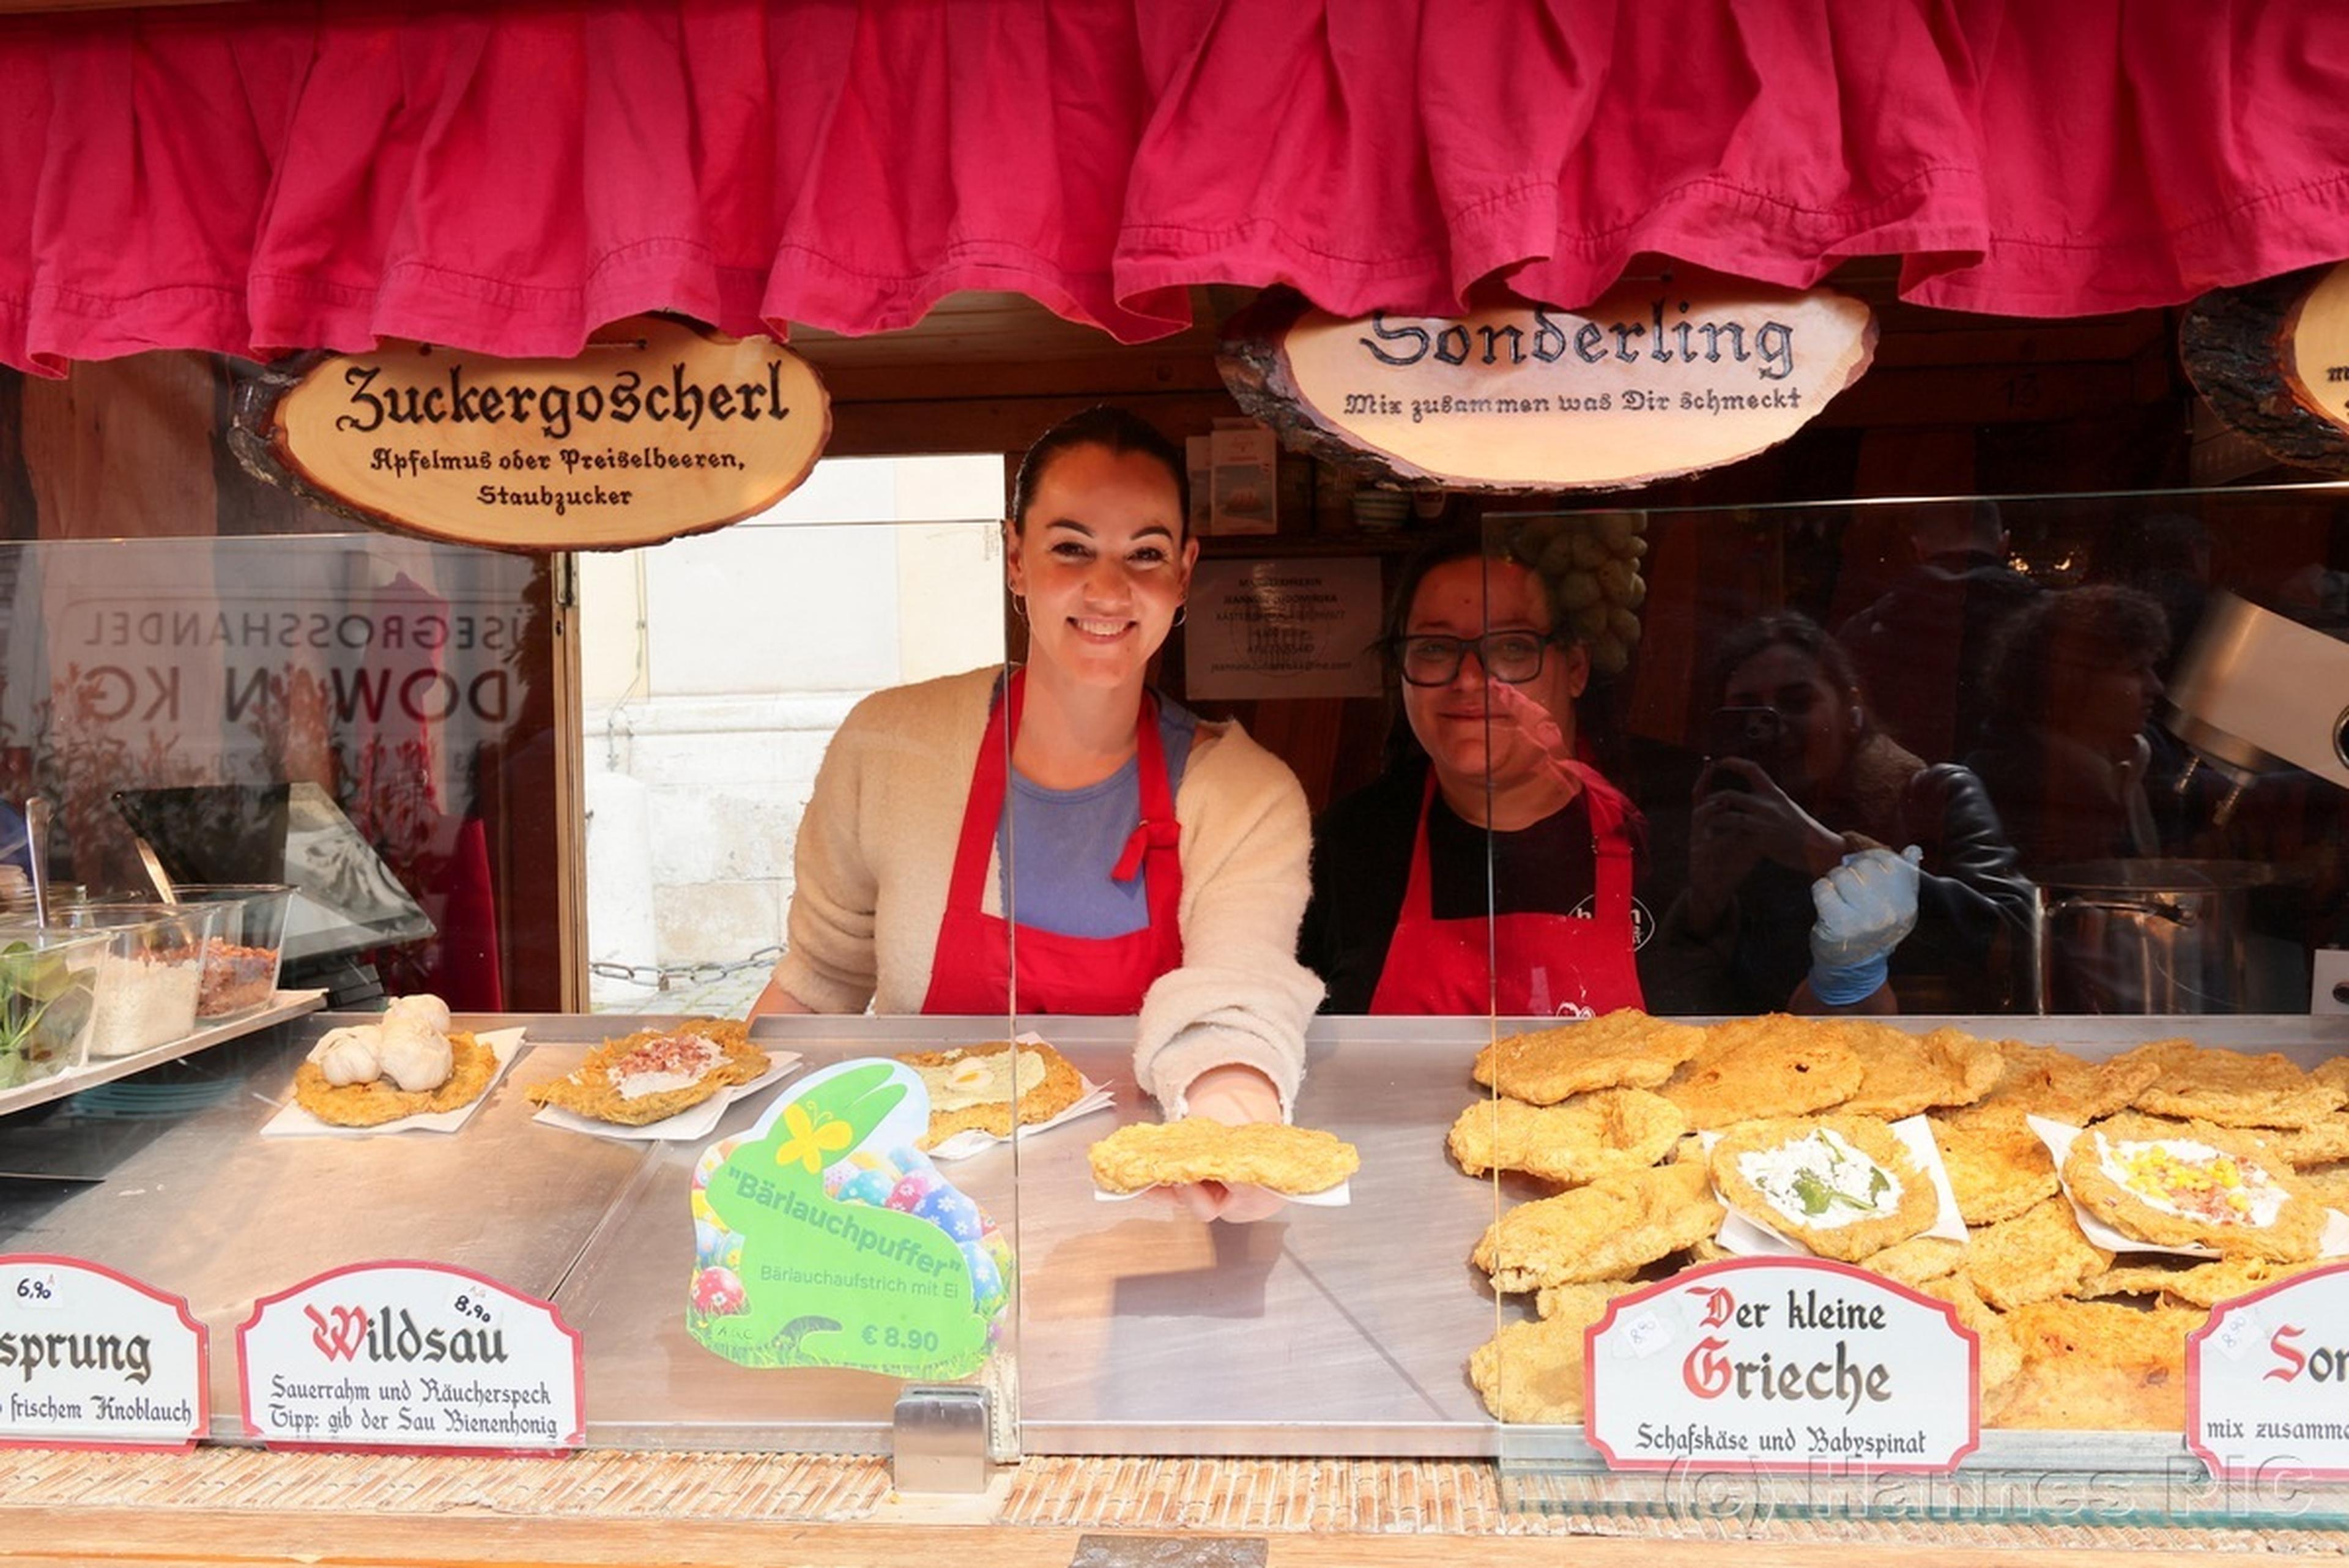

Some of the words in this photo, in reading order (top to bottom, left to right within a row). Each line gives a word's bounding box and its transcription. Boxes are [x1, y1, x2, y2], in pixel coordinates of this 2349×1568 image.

[335, 360, 790, 439] Zuckergoscherl
[1343, 393, 1402, 415] Mix
[1411, 395, 1549, 423] zusammen
[1558, 393, 1612, 412] was
[1622, 390, 1670, 411] Dir
[1679, 386, 1802, 415] schmeckt
[370, 448, 491, 477] Apfelmus
[499, 449, 551, 471] oder
[560, 449, 744, 474] Preiselbeeren,
[477, 485, 632, 515] Staubzucker
[761, 1265, 908, 1293] Bärlauchaufstrich
[911, 1277, 938, 1296] mit
[944, 1283, 959, 1299] Ei
[453, 1295, 492, 1323] 8,90
[1685, 1286, 1770, 1329] Der
[1788, 1289, 1887, 1331] kleine
[303, 1304, 508, 1362] Wildsau
[861, 1325, 879, 1345] €
[885, 1326, 938, 1351] 8.90
[271, 1375, 369, 1402] Sauerrahm
[379, 1380, 412, 1400] und
[420, 1378, 551, 1408] Räucherspeck
[1683, 1336, 1892, 1415] Grieche
[12, 1393, 82, 1424] frischem
[91, 1395, 191, 1425] Knoblauch
[269, 1404, 319, 1434] Tipp:
[328, 1407, 352, 1435] gib
[361, 1408, 388, 1429] der
[396, 1407, 435, 1431] Sau
[445, 1408, 557, 1441] Bienenhonig
[1635, 1422, 1748, 1454] Schafskäse
[1760, 1427, 1796, 1449] und
[1807, 1426, 1926, 1458] Babyspinat
[2207, 1419, 2244, 1438] mix
